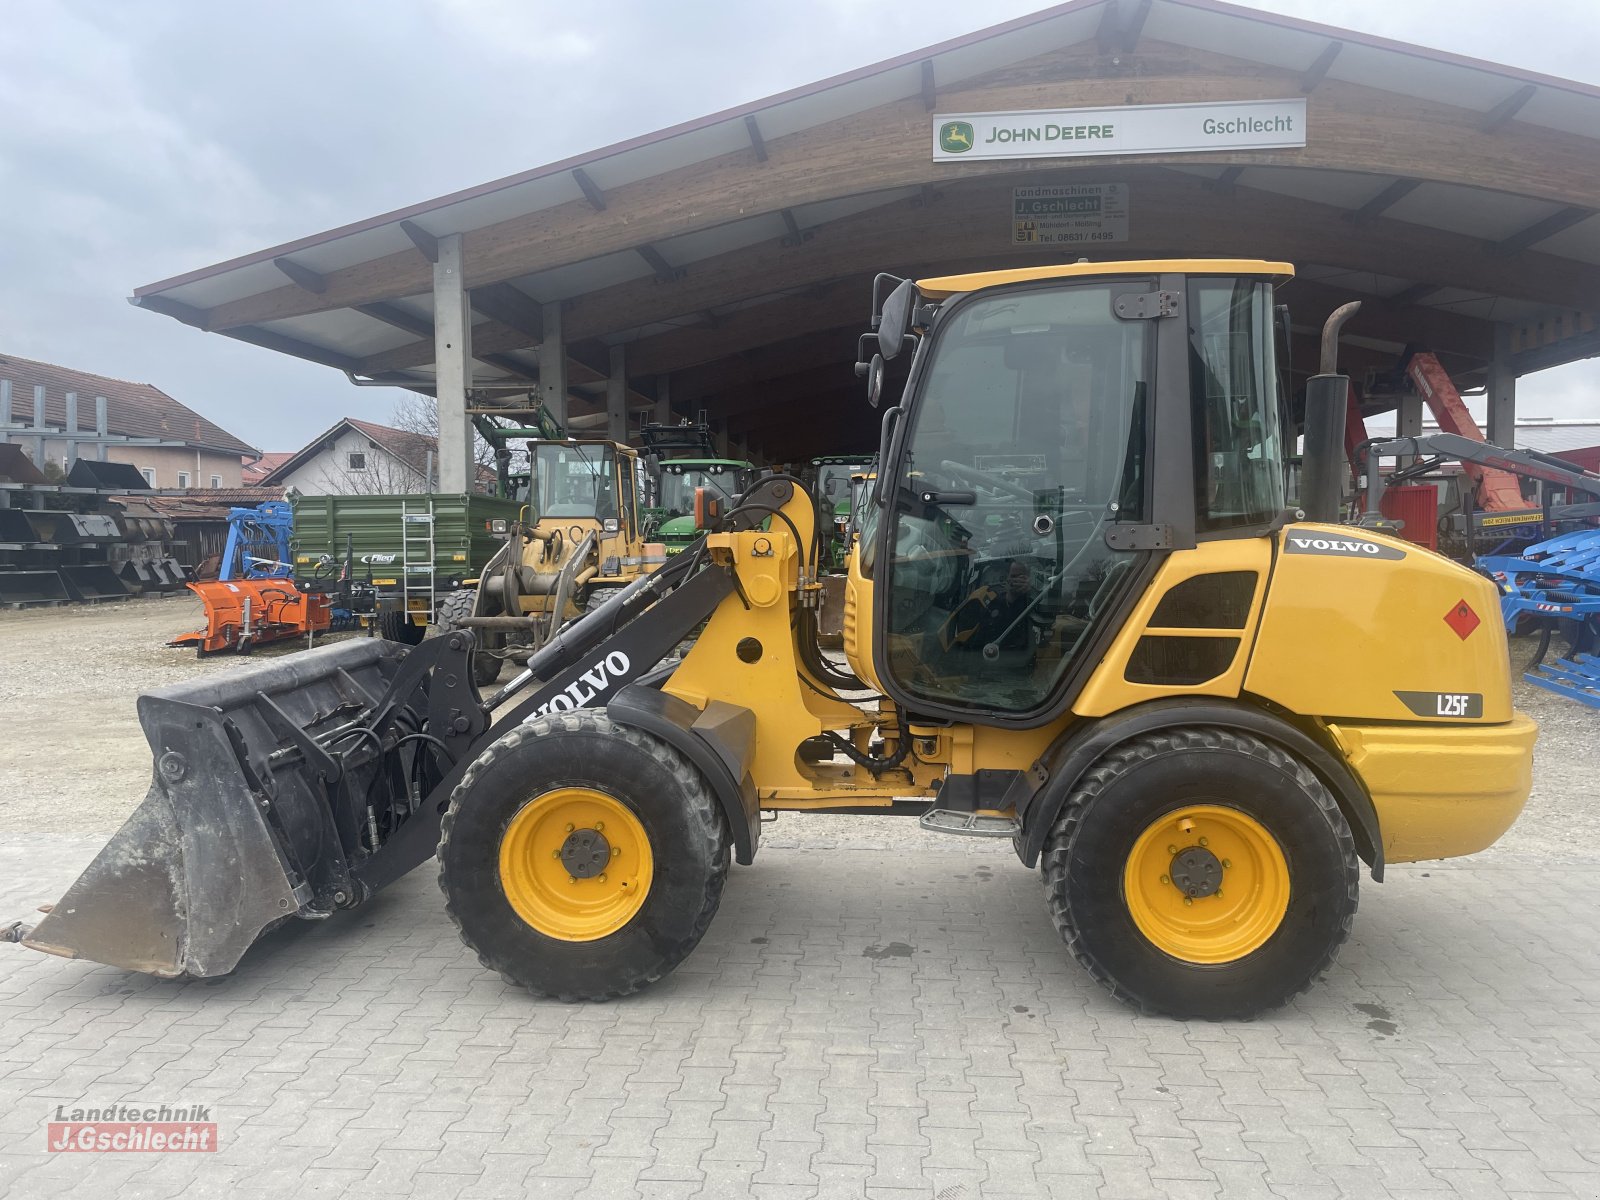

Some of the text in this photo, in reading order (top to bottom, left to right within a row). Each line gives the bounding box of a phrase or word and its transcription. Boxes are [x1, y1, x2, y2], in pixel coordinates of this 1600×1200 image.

[1202, 115, 1293, 135] Gschlecht
[985, 124, 1114, 144] JOHN DEERE
[1015, 186, 1102, 197] Landmaschinen
[1032, 199, 1098, 212] Gschlecht
[1039, 234, 1056, 243] Tel.
[1091, 231, 1114, 241] 6495
[1291, 539, 1379, 554] VOLVO
[1437, 694, 1469, 716] L25F
